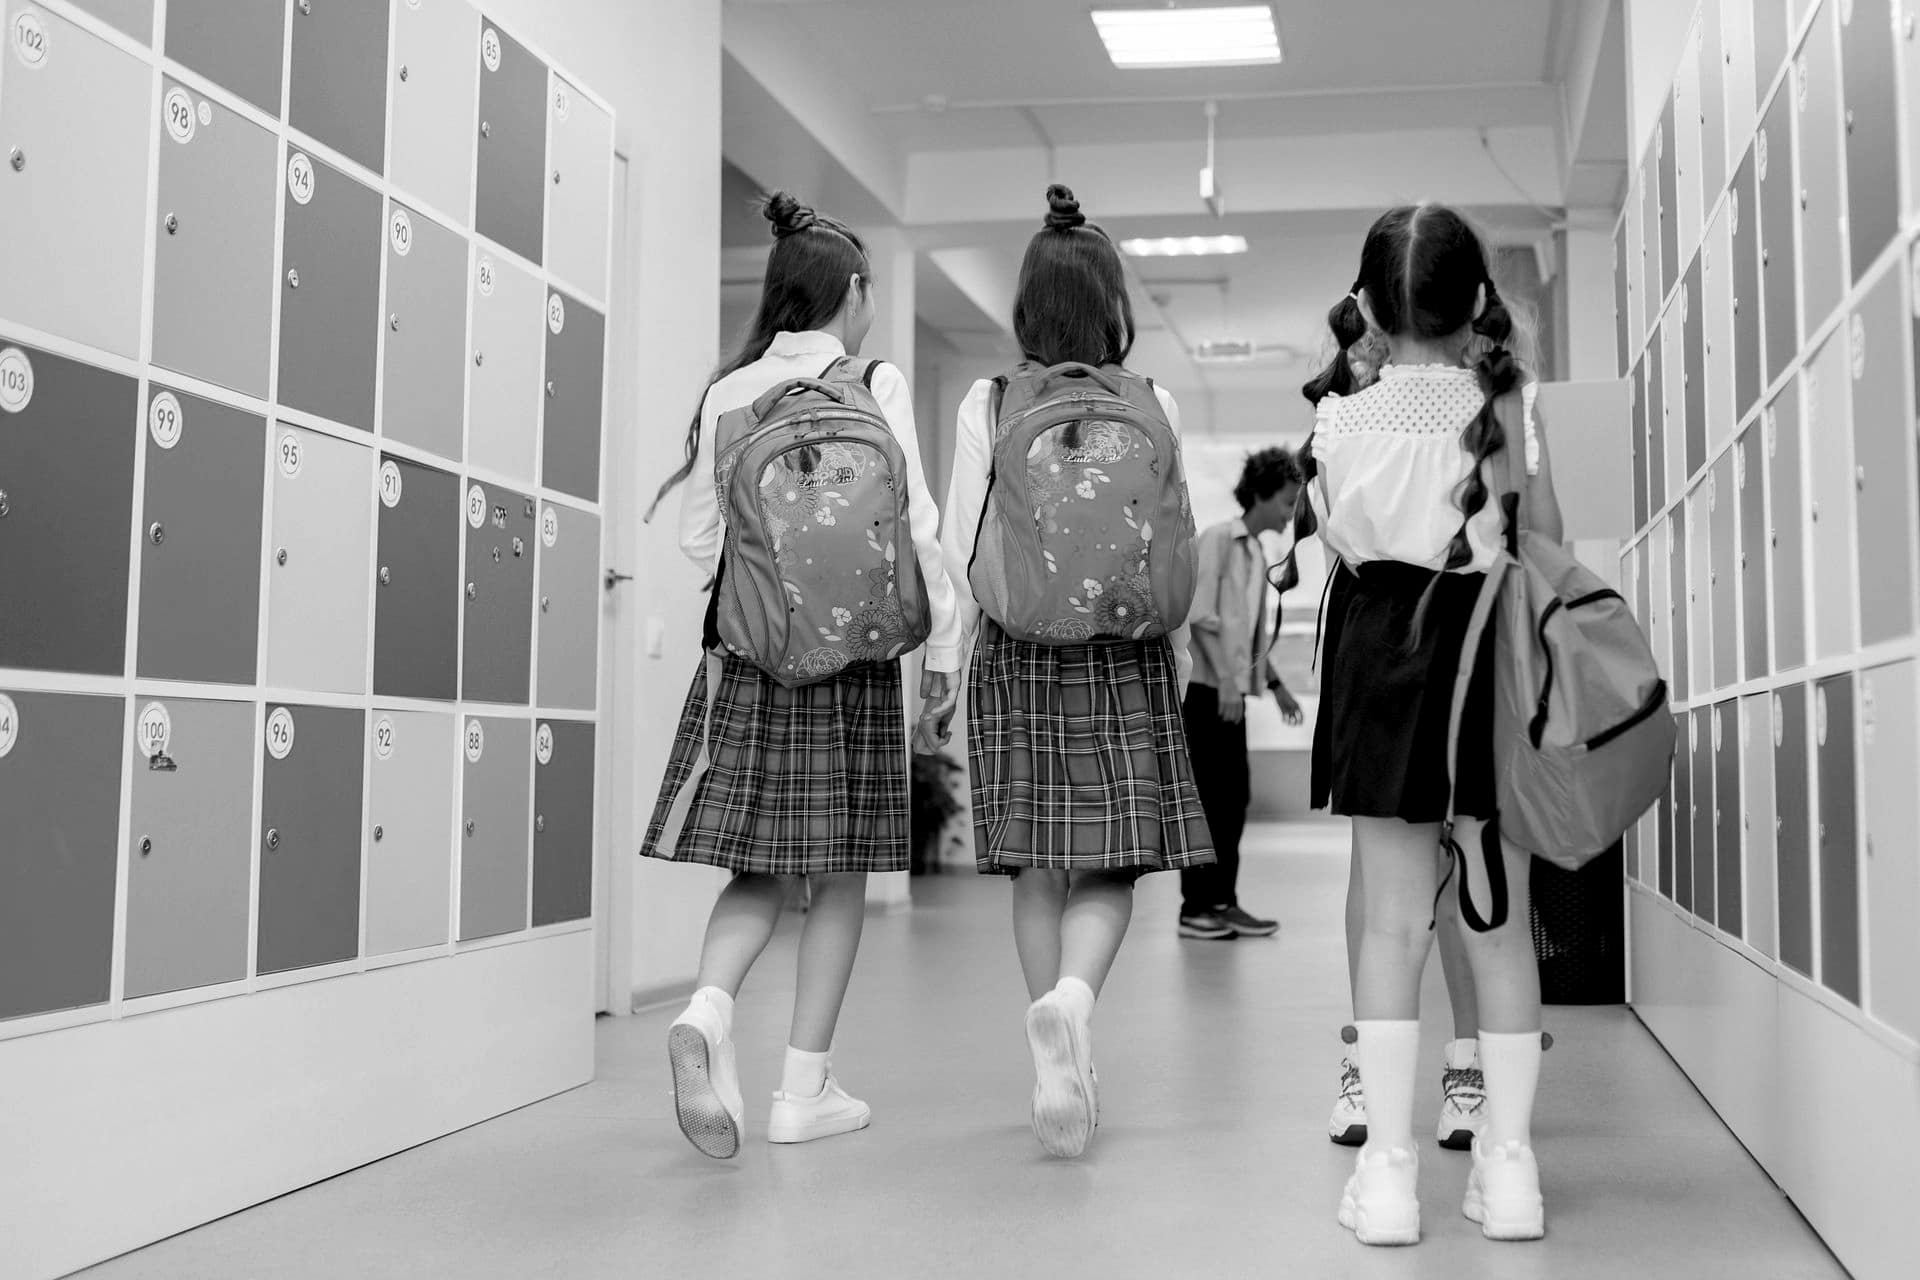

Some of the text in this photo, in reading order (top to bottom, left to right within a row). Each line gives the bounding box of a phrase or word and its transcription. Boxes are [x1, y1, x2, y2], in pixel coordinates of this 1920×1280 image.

[19, 25, 42, 51] 102
[486, 40, 497, 60] 85
[171, 102, 188, 129] 98
[294, 167, 309, 190] 94
[395, 222, 408, 244] 90
[480, 266, 491, 285] 86
[551, 305, 561, 323] 82
[0, 368, 25, 391] 103
[157, 408, 175, 432] 99
[282, 444, 297, 465] 95
[384, 474, 396, 495] 91
[470, 497, 482, 516] 87
[544, 519, 554, 536] 83
[145, 722, 164, 739] 100
[273, 723, 288, 744] 96
[378, 728, 390, 747] 92
[469, 732, 480, 749] 88
[540, 736, 550, 752] 84
